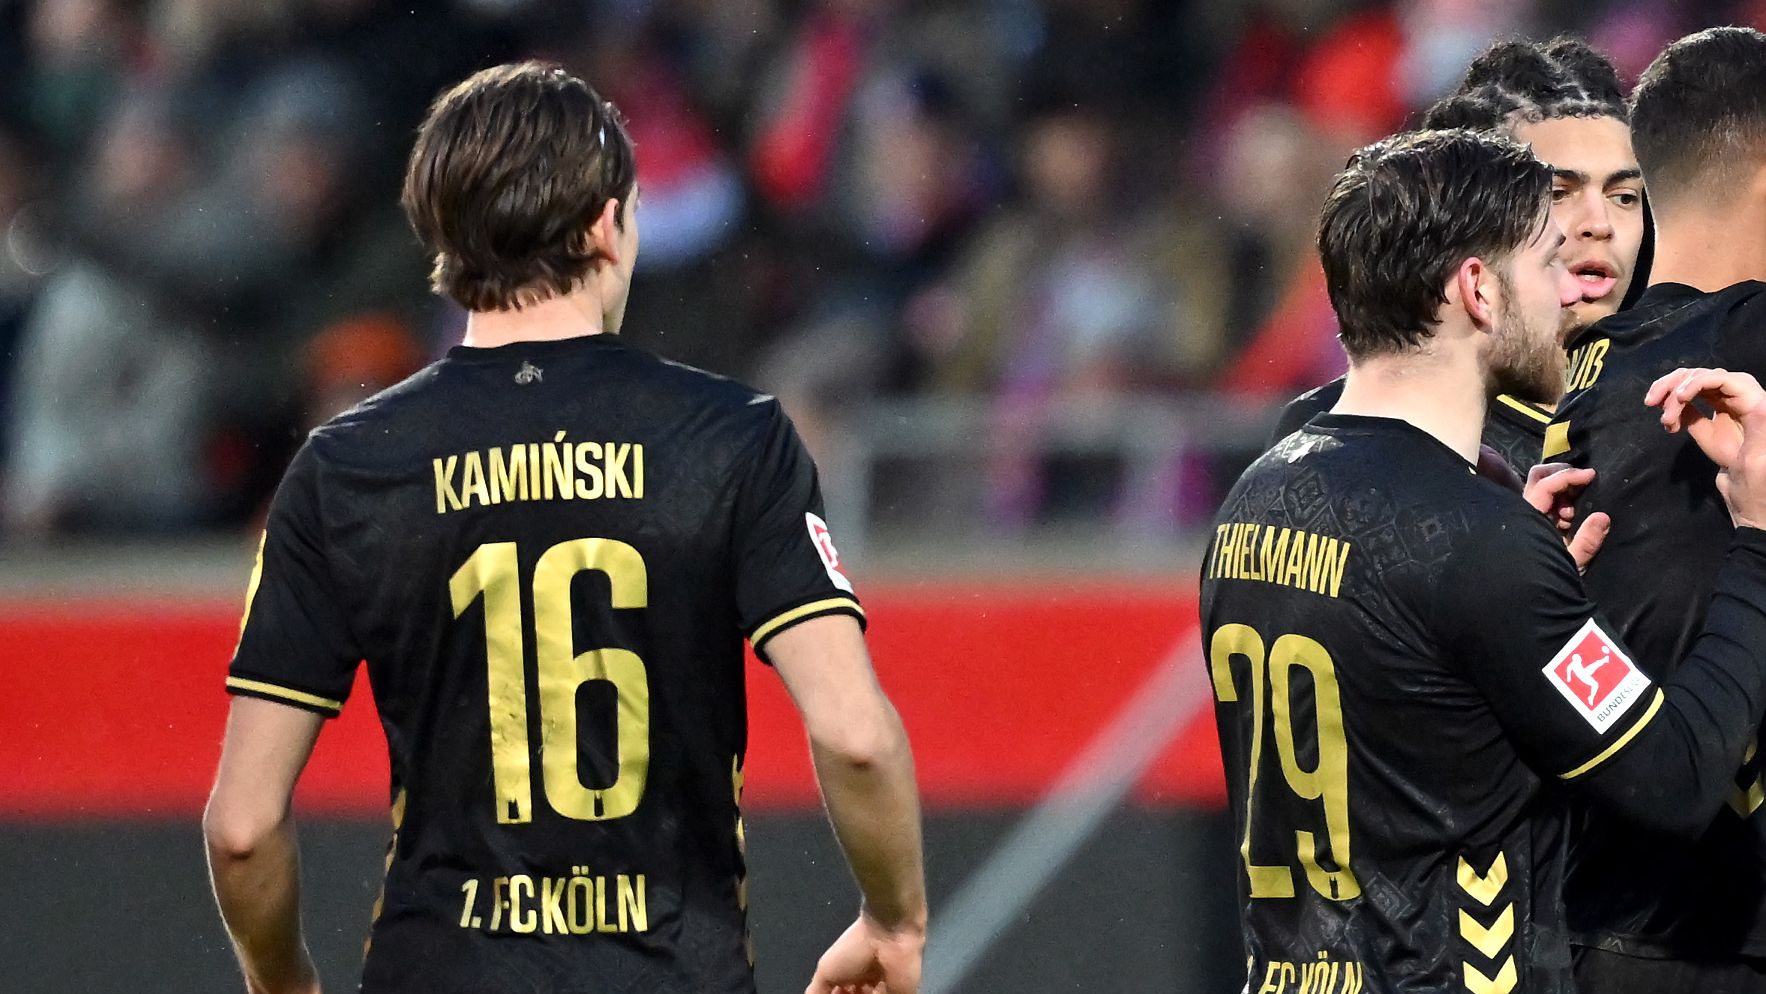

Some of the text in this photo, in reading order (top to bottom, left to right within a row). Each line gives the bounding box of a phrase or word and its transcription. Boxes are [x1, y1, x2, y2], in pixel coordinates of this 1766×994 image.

[433, 431, 645, 513] KAMIŃSKI
[1209, 522, 1351, 598] THIELMANN
[449, 537, 650, 825] 16
[1210, 623, 1361, 900] 29
[490, 874, 538, 933] FC
[541, 865, 649, 935] KÖLN
